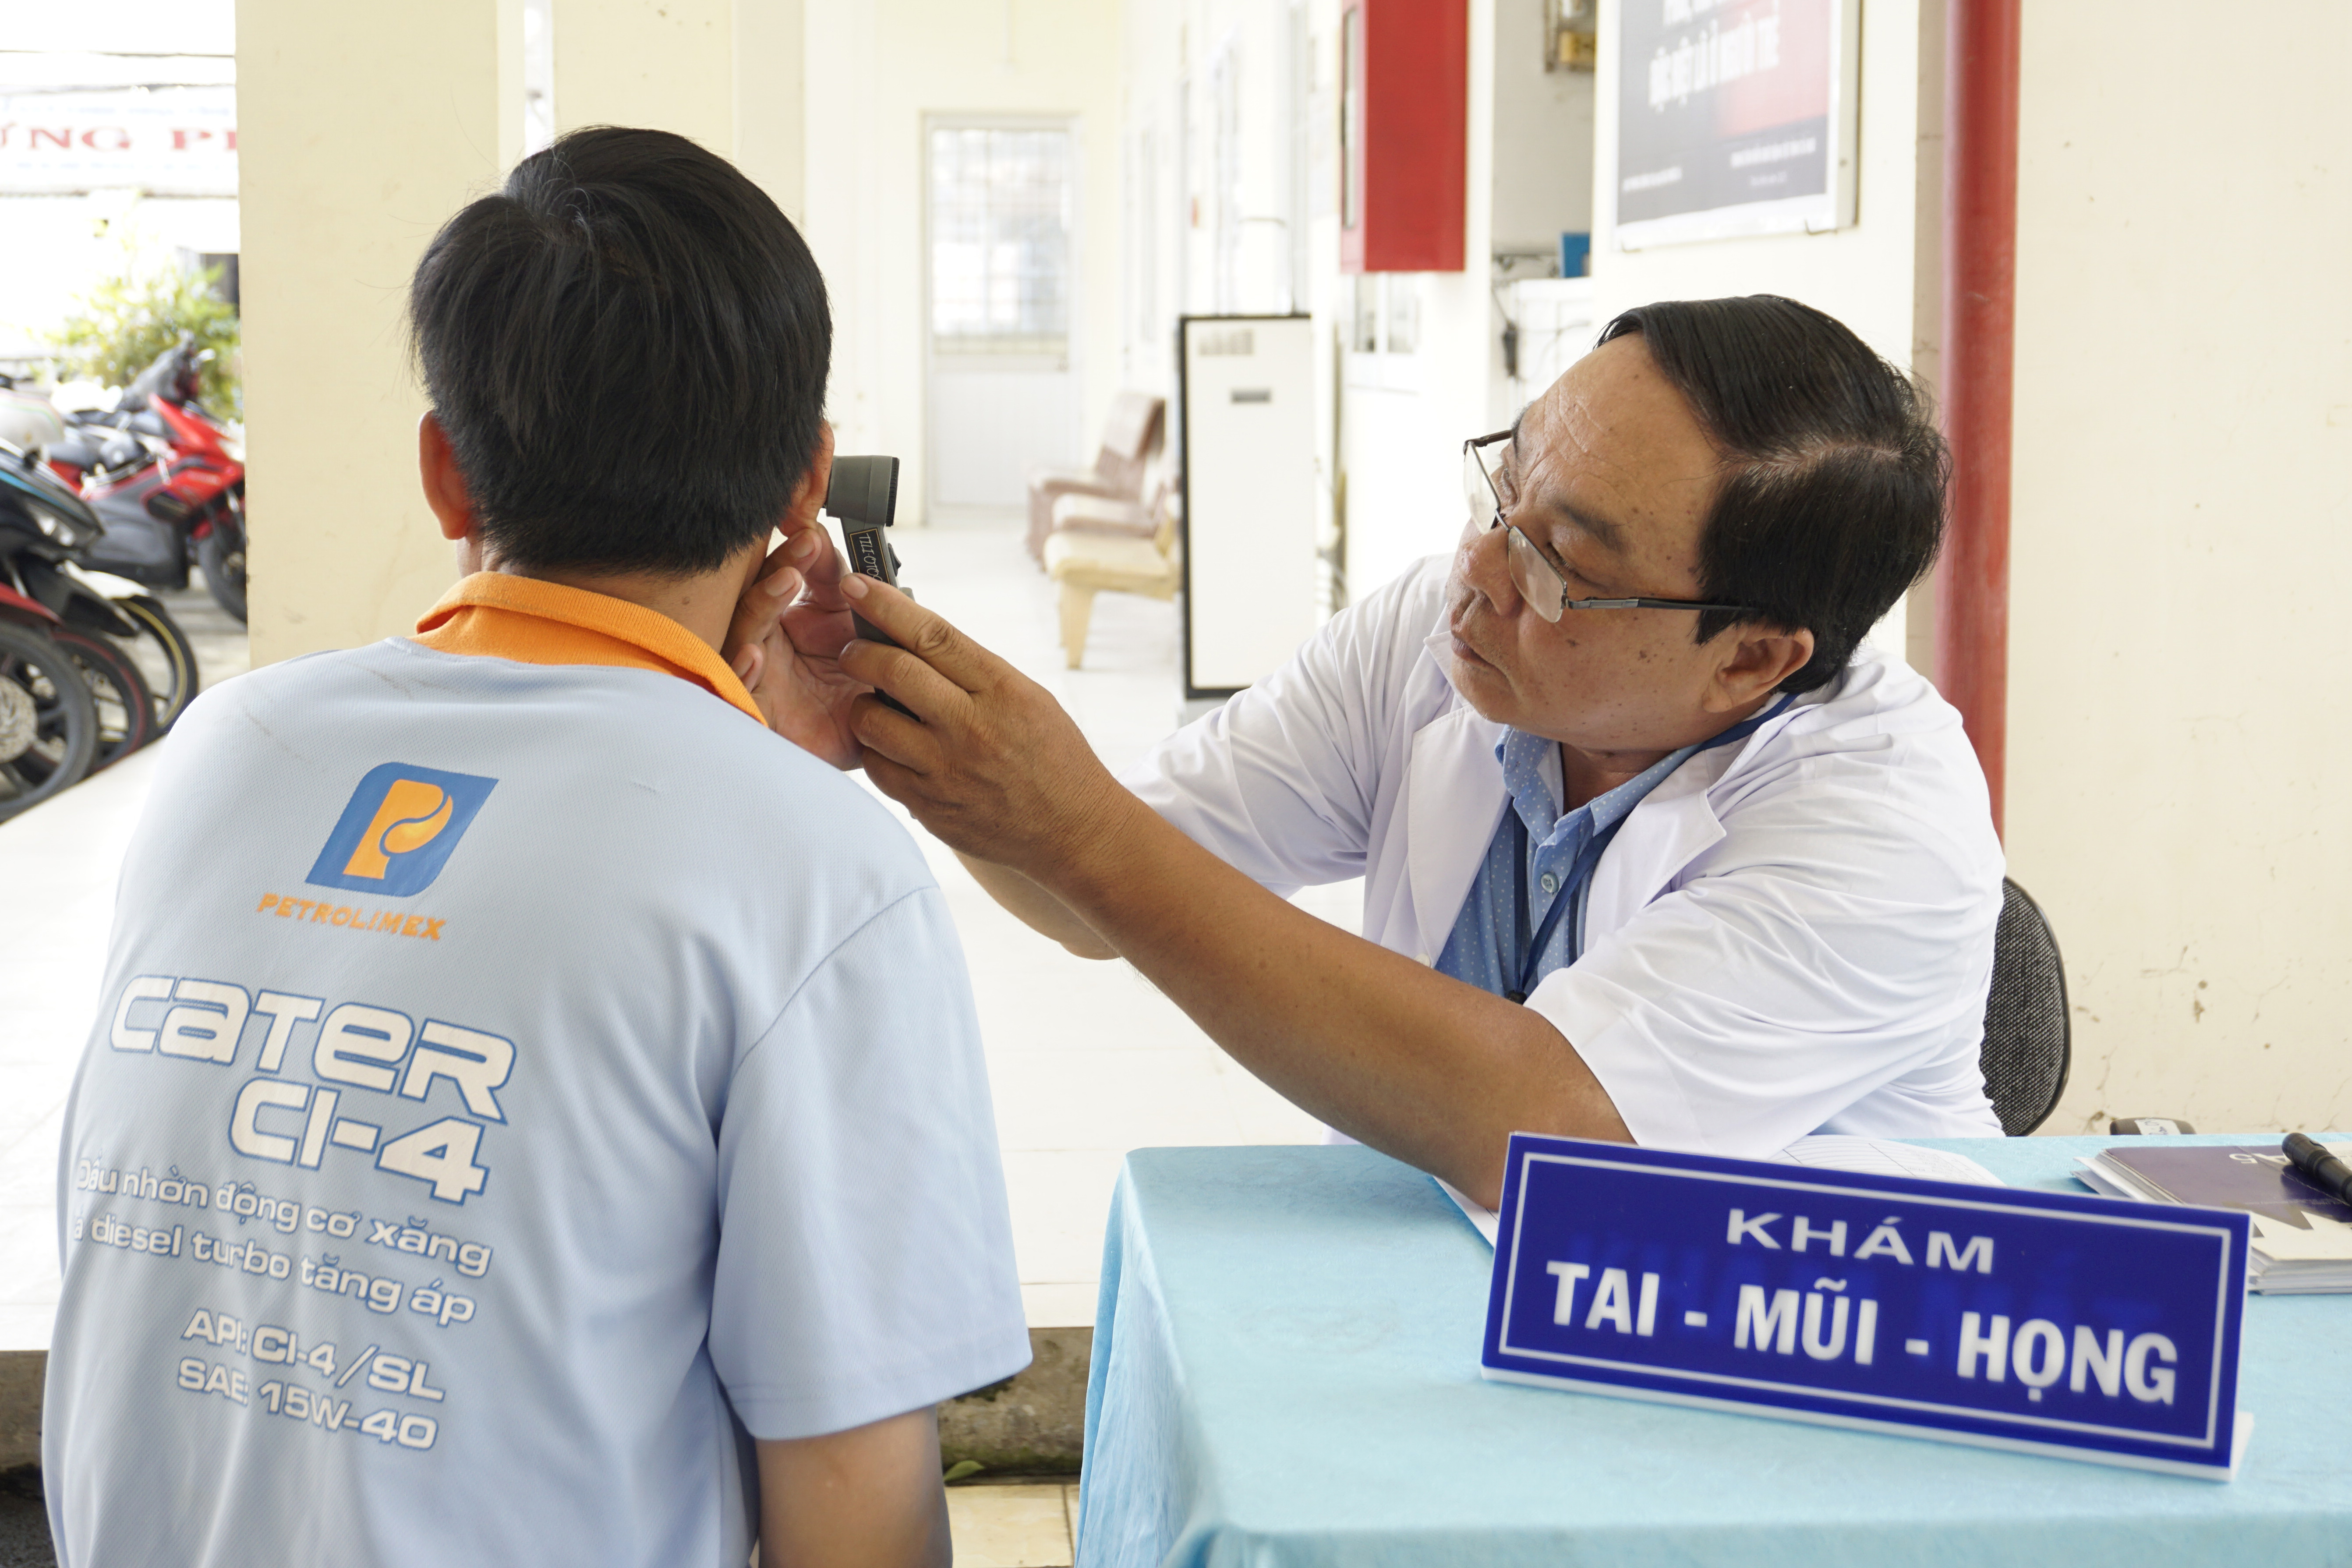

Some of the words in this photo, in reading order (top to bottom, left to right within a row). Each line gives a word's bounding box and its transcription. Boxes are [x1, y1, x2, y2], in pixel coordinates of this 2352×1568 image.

[257, 892, 446, 941] PETROLIMEX
[227, 1077, 490, 1205] CI-4
[90, 1212, 184, 1258] diesel
[191, 1231, 292, 1281] turbo
[301, 1252, 404, 1315] tăng
[408, 1277, 477, 1327] áp
[121, 1164, 210, 1209] nhờn
[215, 1180, 301, 1234] động
[306, 1207, 362, 1239] cơ
[364, 1215, 493, 1278] xăng
[1726, 1208, 1994, 1274] KHÁM
[180, 1307, 248, 1356] API:
[1546, 1260, 1660, 1337] TAI
[1733, 1277, 1878, 1365] MŨI
[1957, 1312, 2178, 1405] HỌNG
[177, 1356, 248, 1407] SAE:
[258, 1379, 439, 1451] 15W-40
